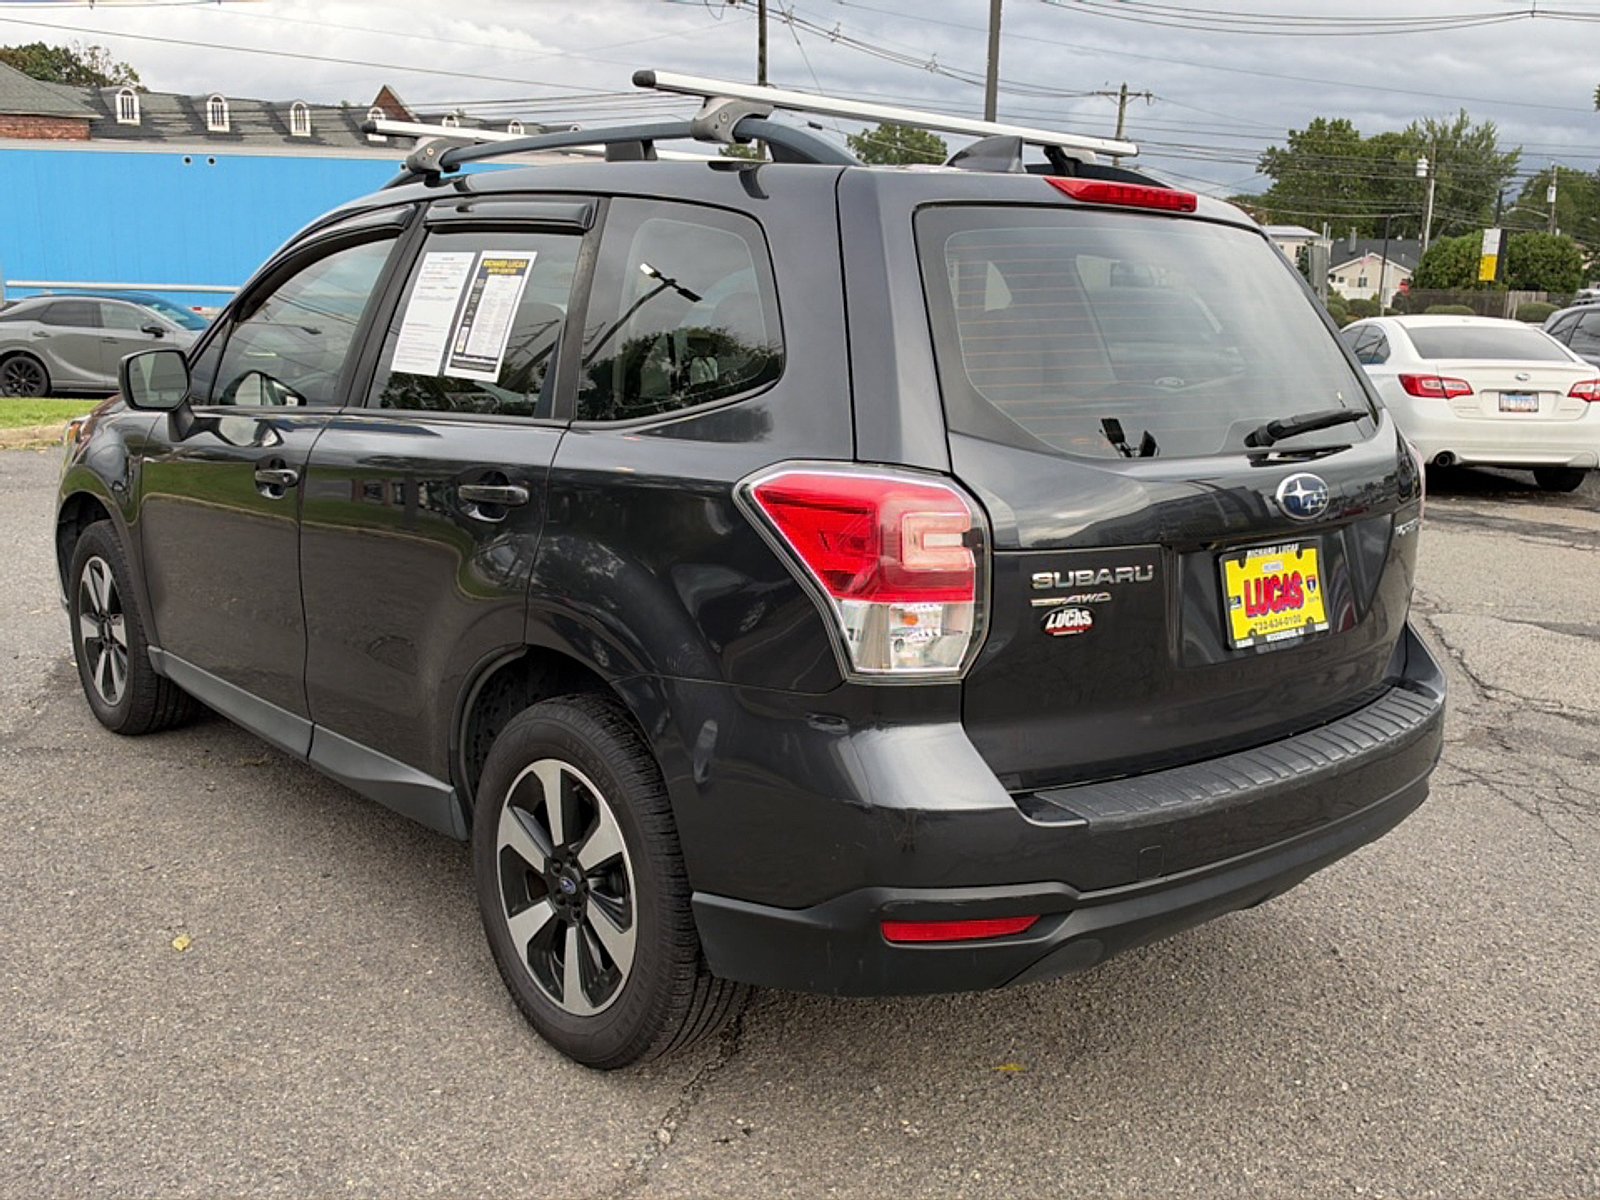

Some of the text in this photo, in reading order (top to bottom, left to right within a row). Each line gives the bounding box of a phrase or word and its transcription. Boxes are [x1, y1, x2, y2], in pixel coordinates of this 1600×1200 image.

[1031, 565, 1154, 590] SUBARU
[1063, 592, 1112, 605] AWD
[1243, 570, 1305, 618] LUCAS
[1044, 608, 1093, 630] LUCAS
